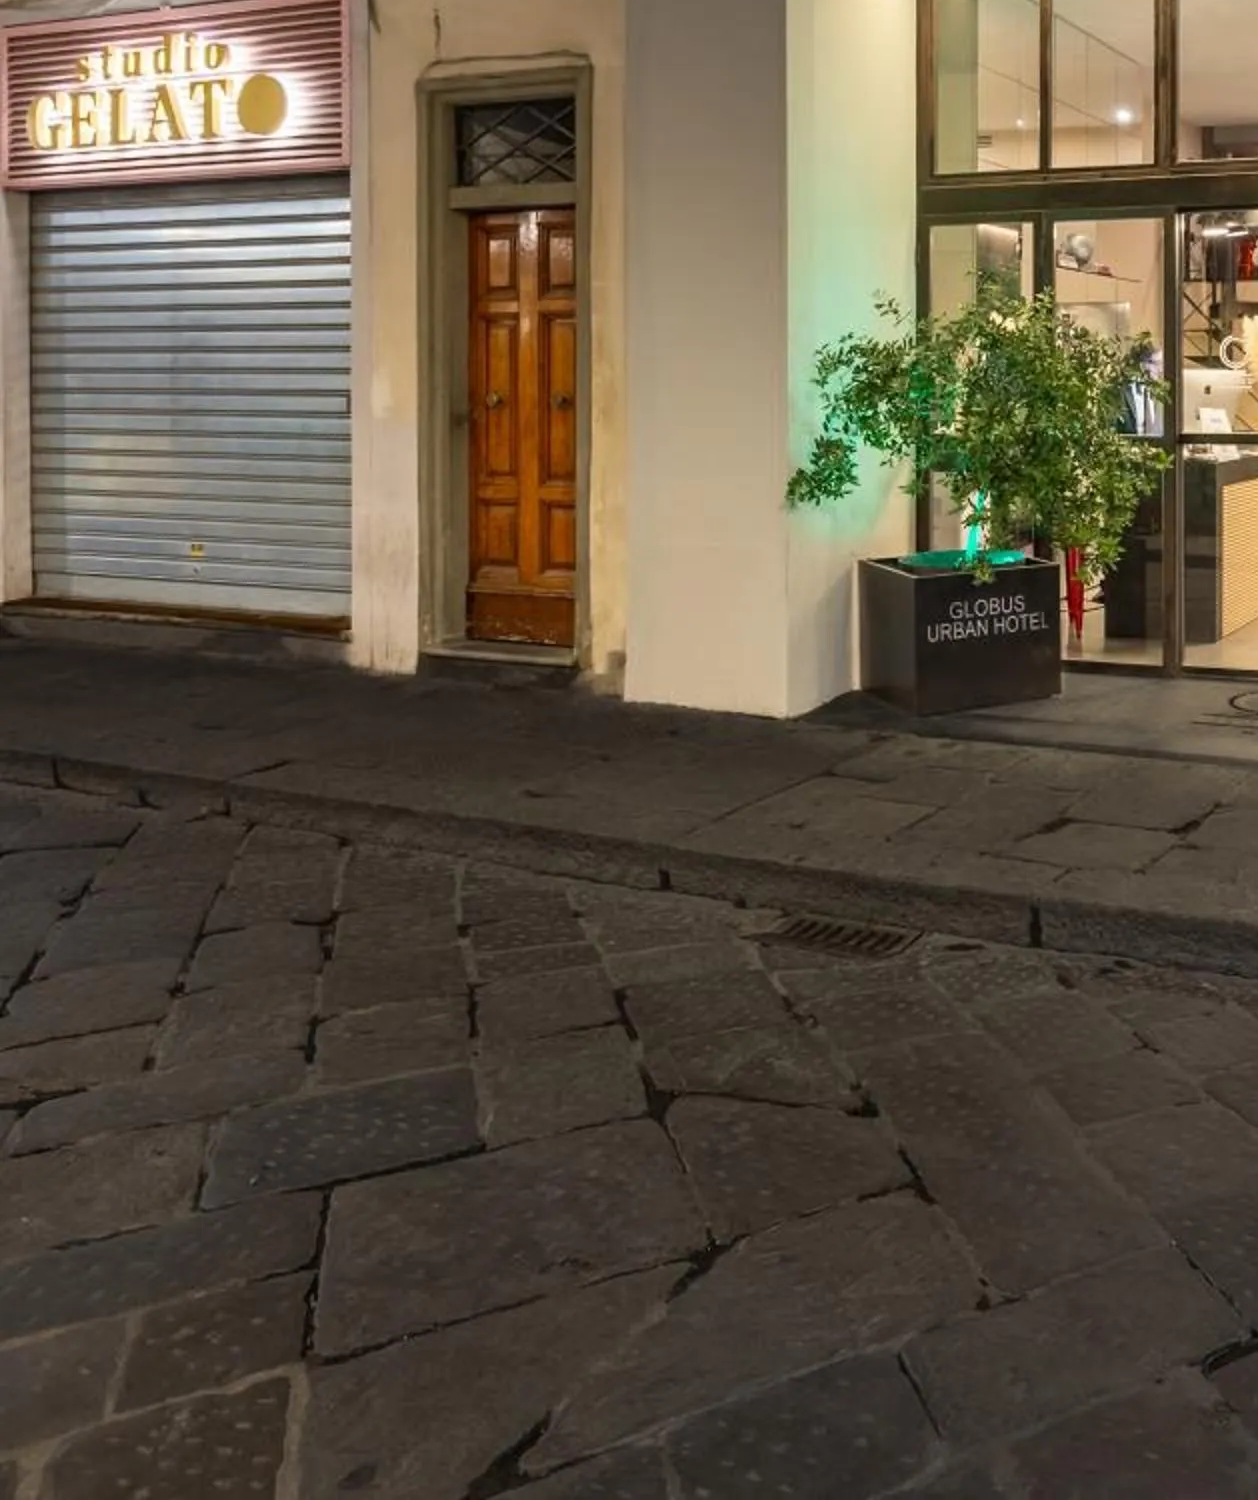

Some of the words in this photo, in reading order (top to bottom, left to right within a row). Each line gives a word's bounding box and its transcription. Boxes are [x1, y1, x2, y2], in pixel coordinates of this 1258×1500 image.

[76, 31, 232, 82] studio
[27, 73, 289, 152] GELATO
[927, 619, 989, 643] URBAN
[993, 611, 1050, 634] HOTEL
[950, 595, 1026, 619] GLOBUS
